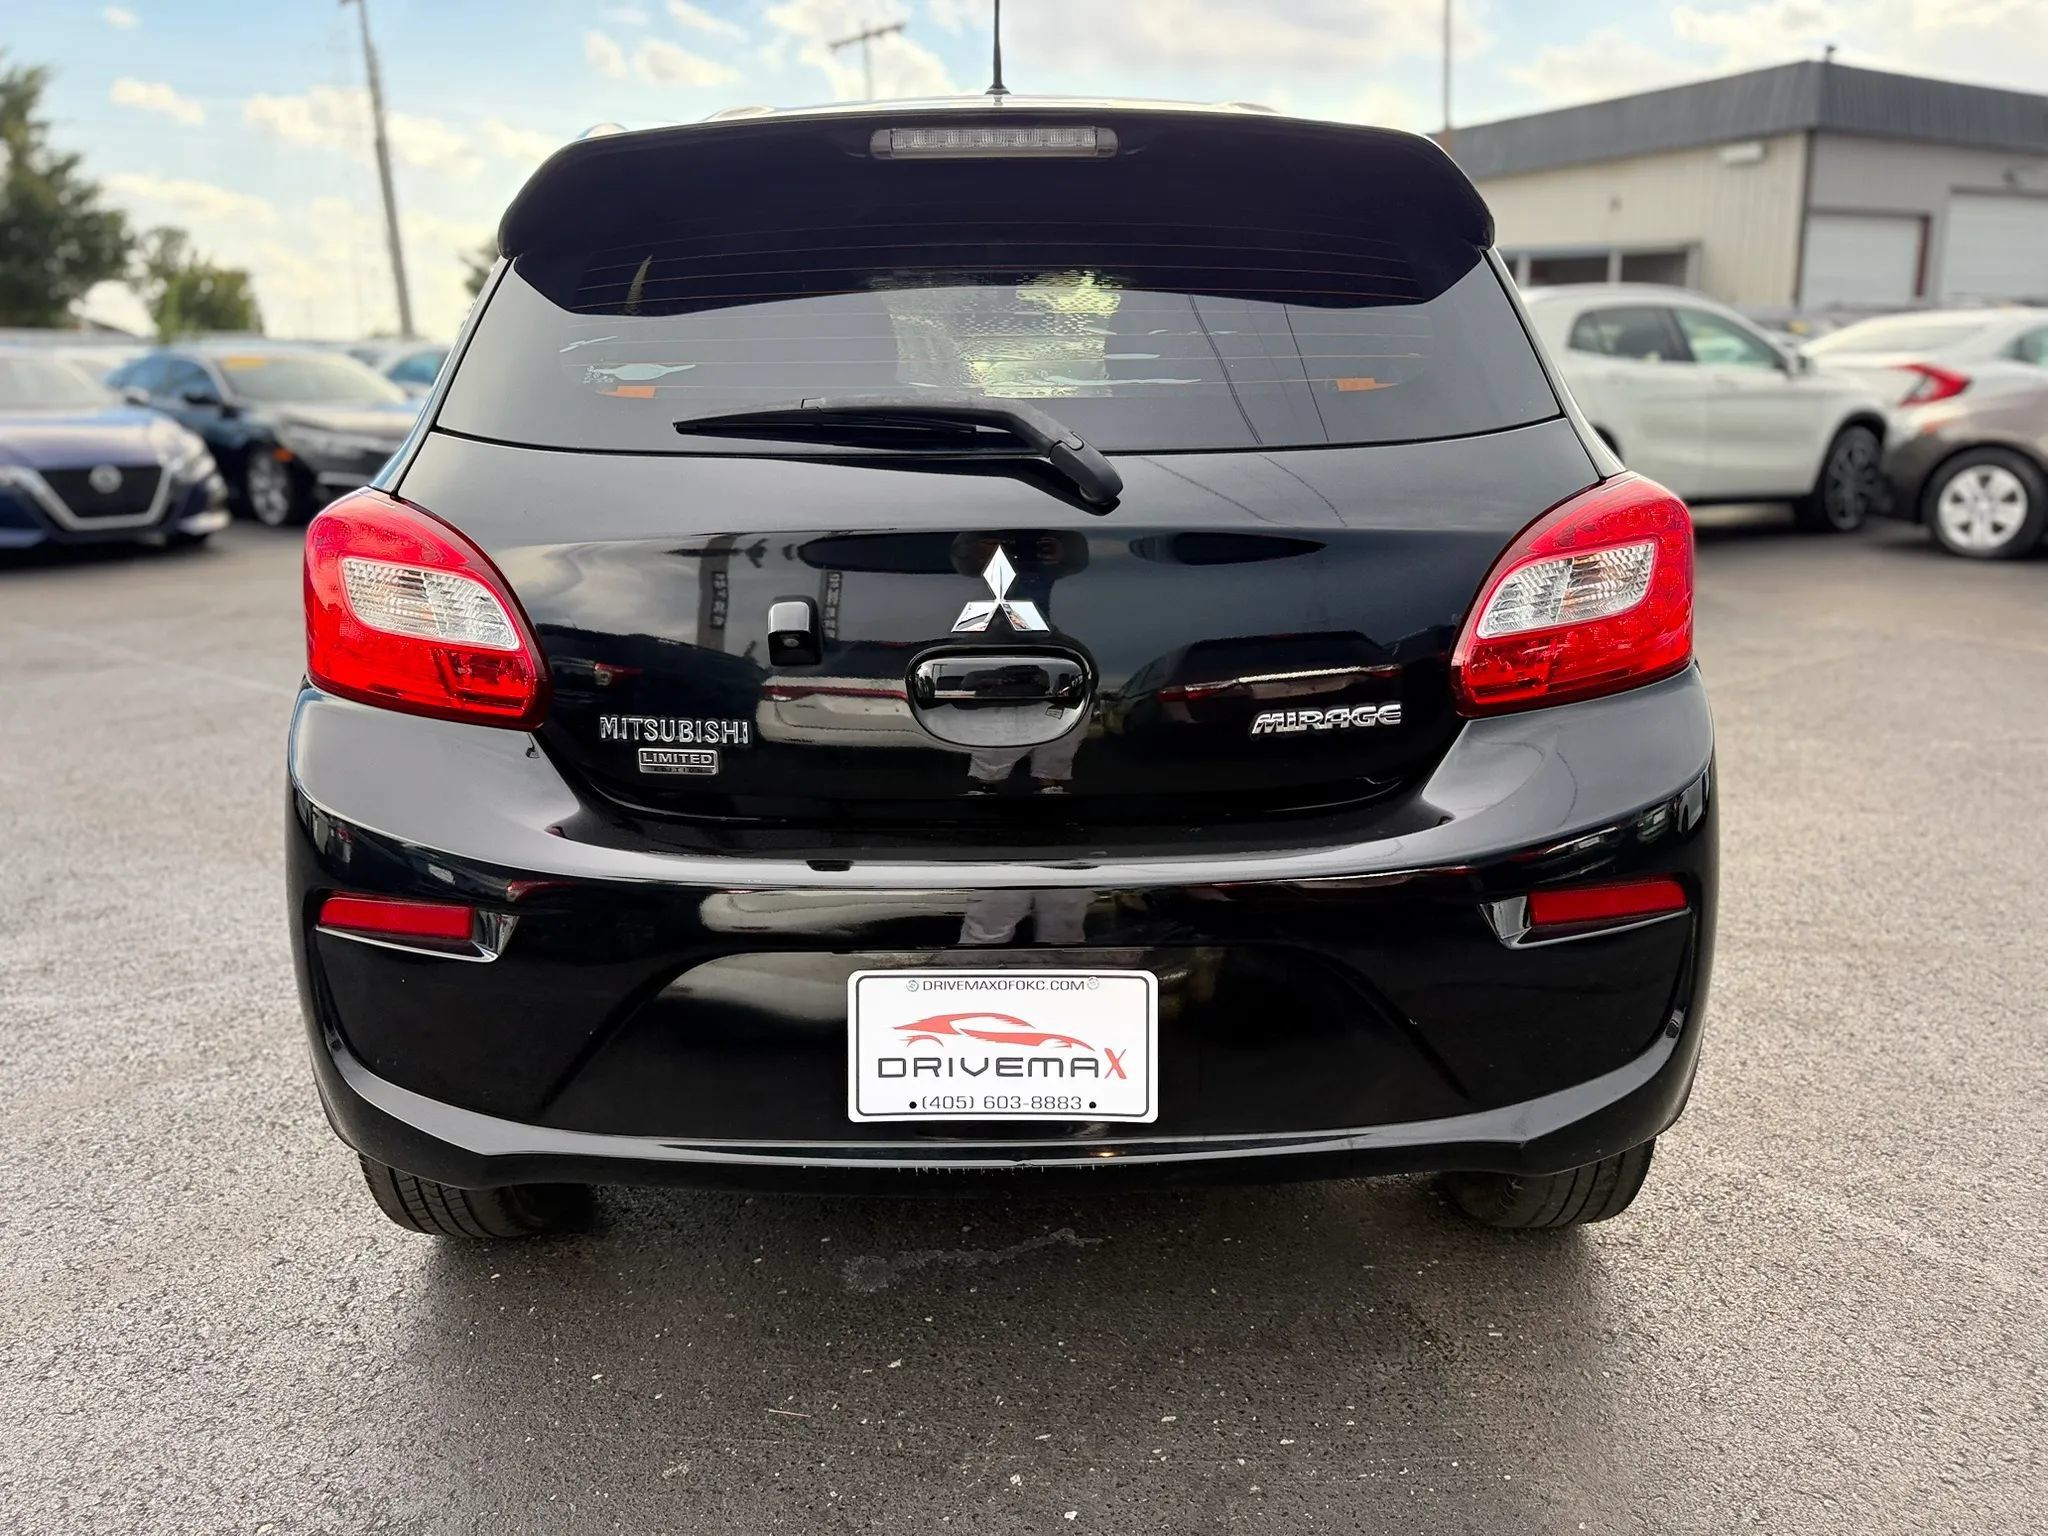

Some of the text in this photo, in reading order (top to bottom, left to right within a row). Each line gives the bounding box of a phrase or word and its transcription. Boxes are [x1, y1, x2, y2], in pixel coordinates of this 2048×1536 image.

[599, 716, 749, 744] MITSUBISHI
[1251, 704, 1402, 734] MIRAGE
[642, 752, 713, 764] LIMITED
[922, 979, 1086, 992] DRIVEMAXOFOKC.COM
[877, 1047, 1128, 1080] DRIVEMAX
[921, 1095, 1083, 1111] (405) 603-8883
